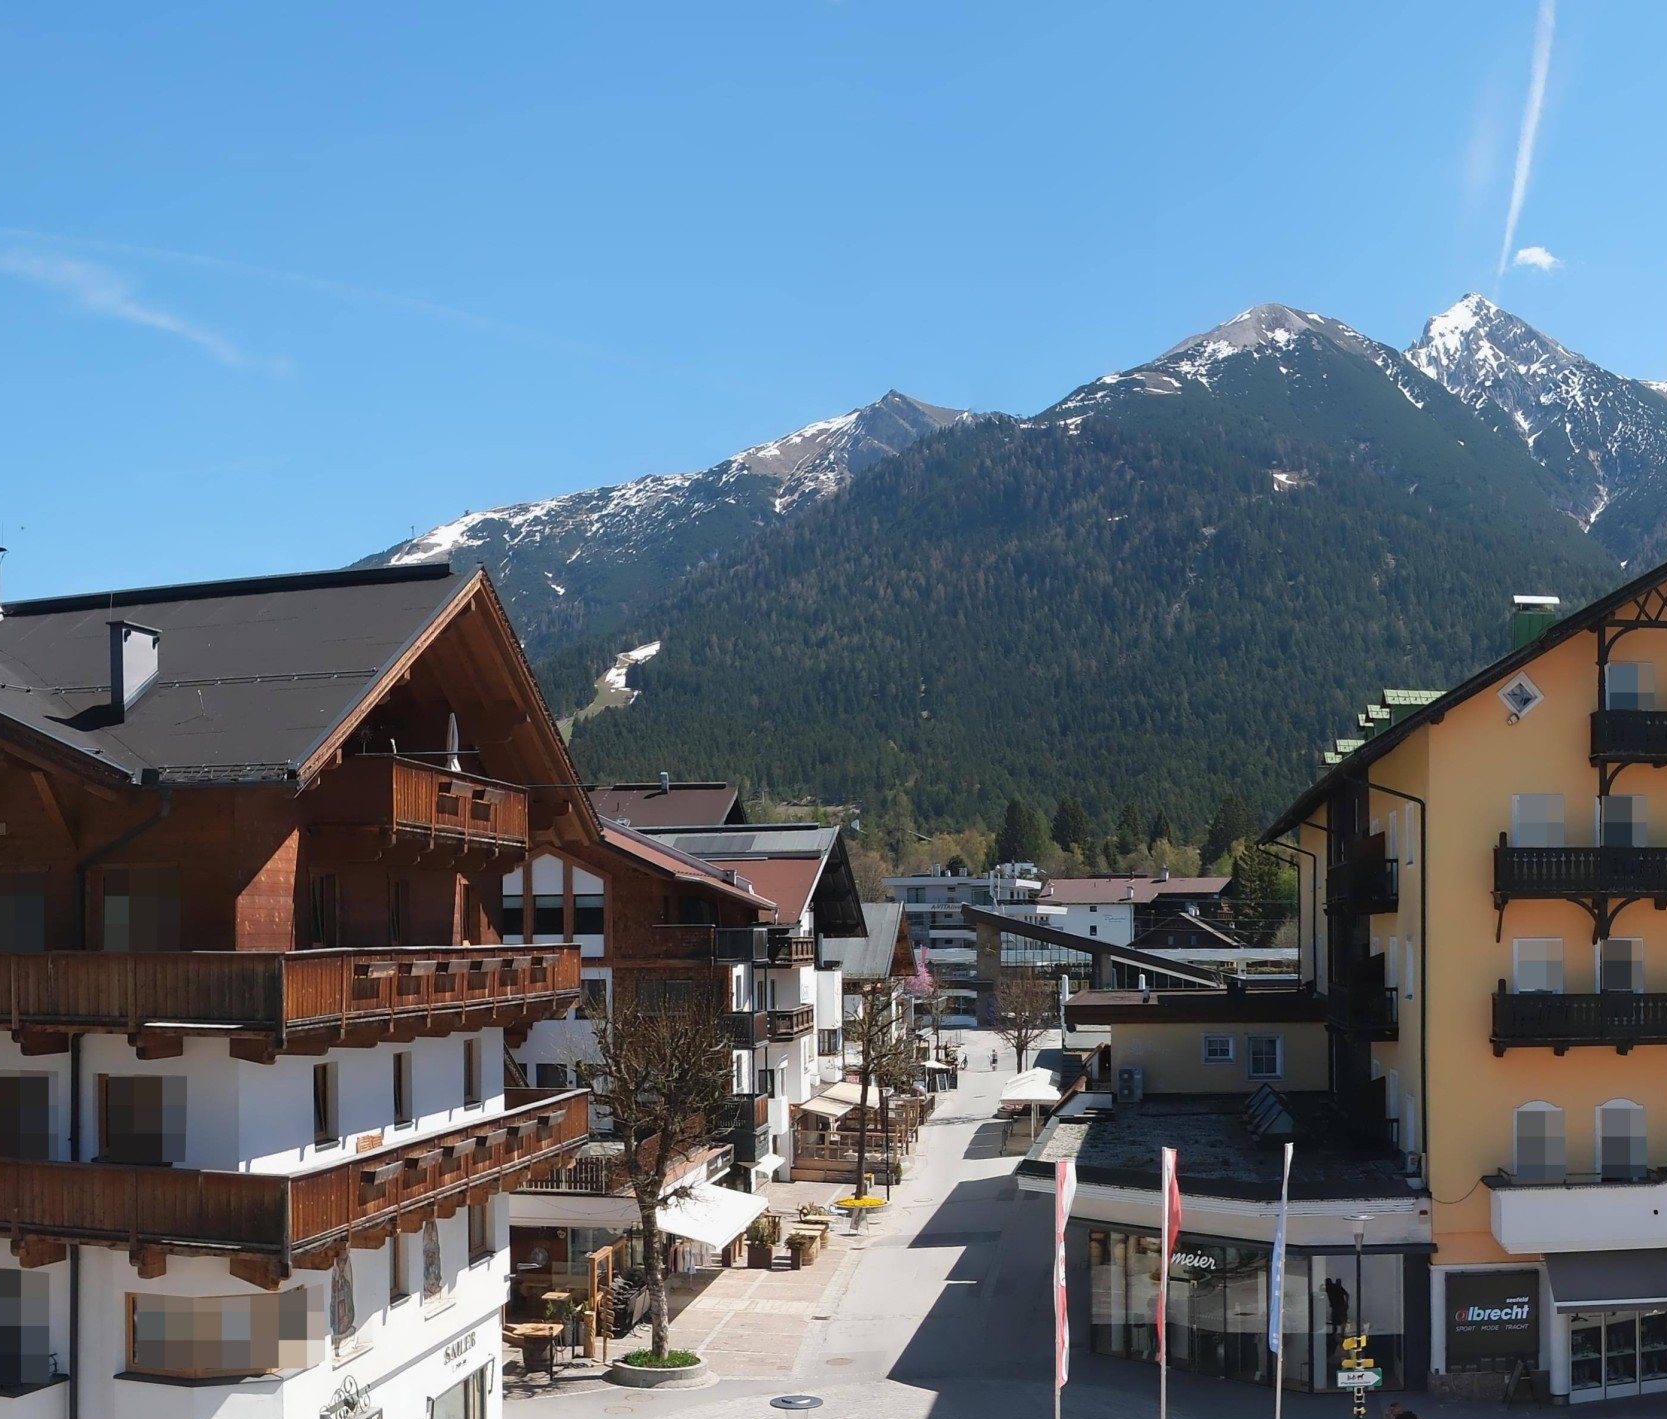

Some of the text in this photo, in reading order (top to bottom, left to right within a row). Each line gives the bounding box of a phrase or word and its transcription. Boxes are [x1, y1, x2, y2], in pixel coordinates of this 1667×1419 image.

[1455, 1304, 1530, 1322] albrecht
[1455, 1325, 1476, 1333] SPORT
[1505, 1323, 1529, 1331] TRACHT
